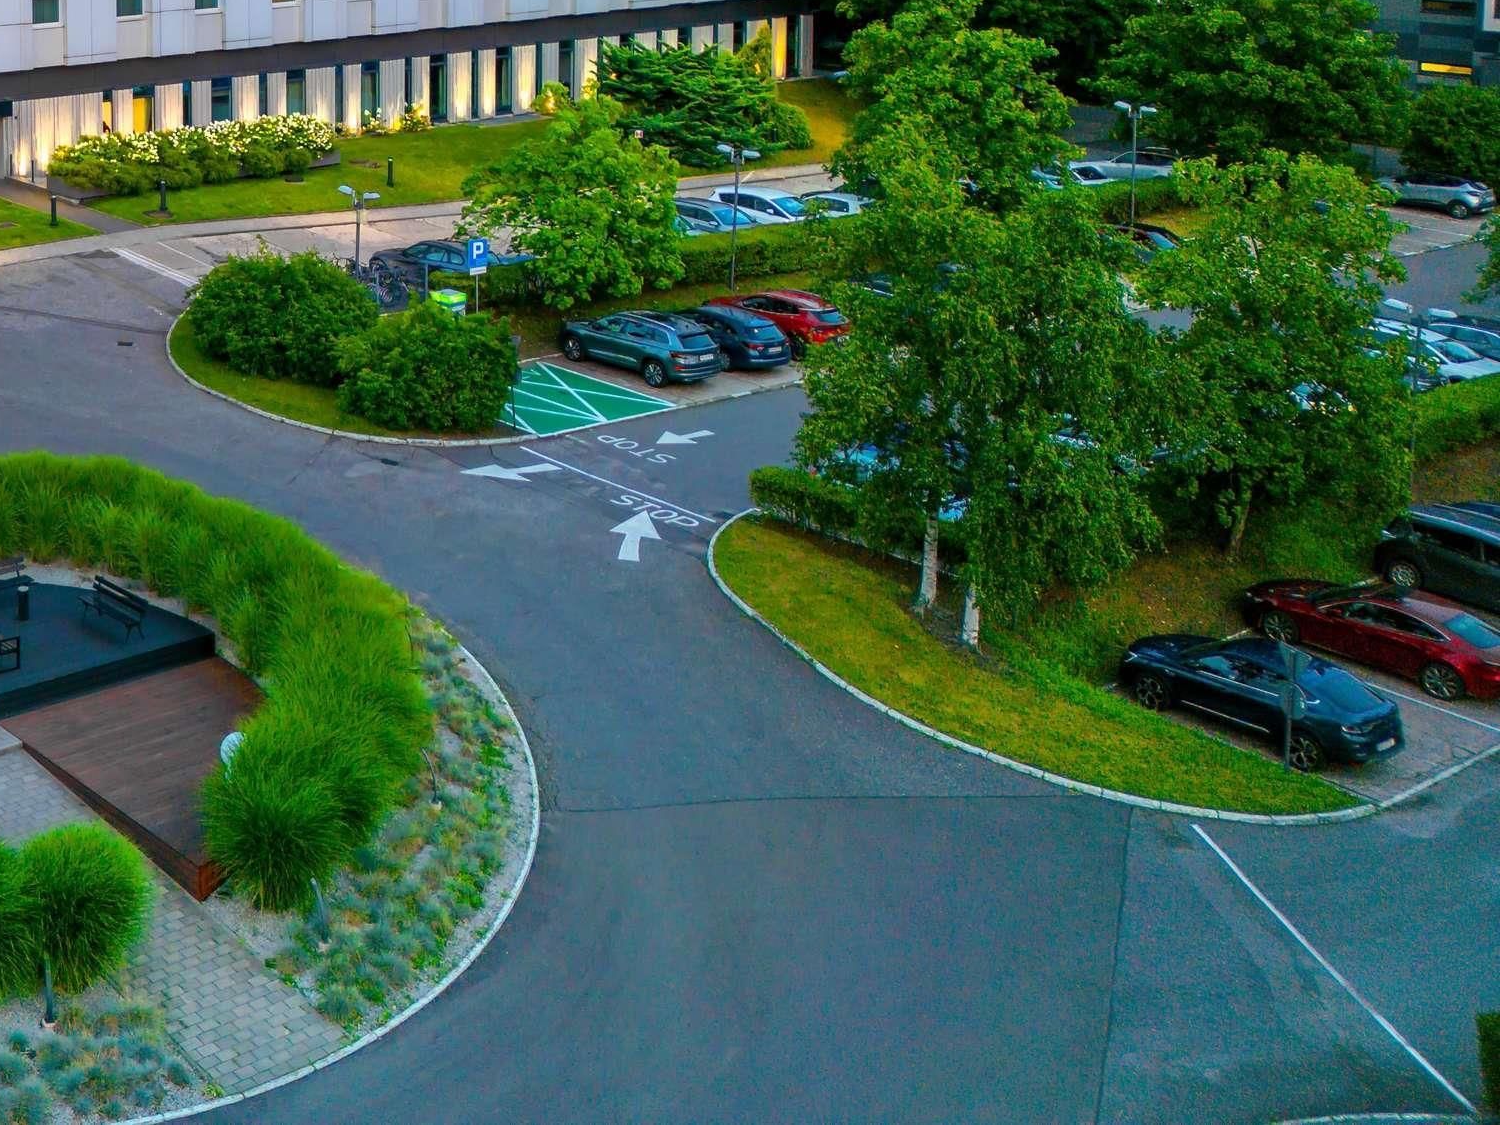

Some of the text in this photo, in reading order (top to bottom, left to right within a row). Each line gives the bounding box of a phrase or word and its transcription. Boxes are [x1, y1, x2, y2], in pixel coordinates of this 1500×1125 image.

[472, 241, 484, 260] P
[597, 435, 677, 464] STOP
[609, 495, 699, 526] STOP
